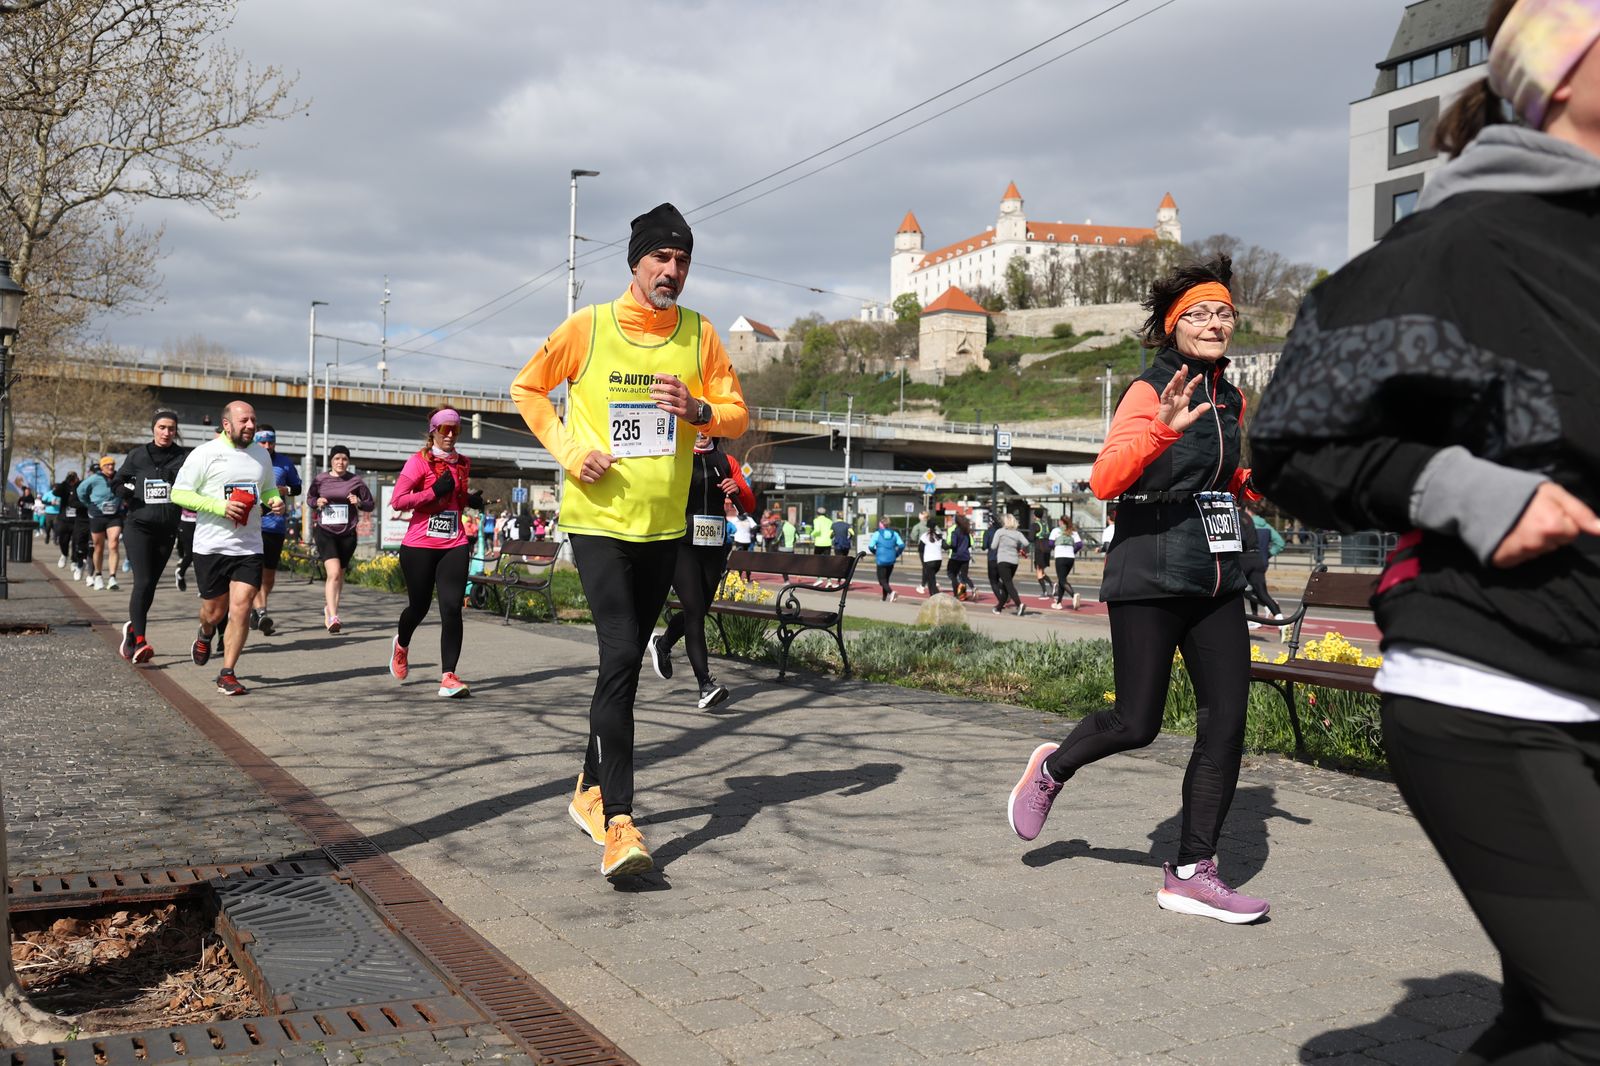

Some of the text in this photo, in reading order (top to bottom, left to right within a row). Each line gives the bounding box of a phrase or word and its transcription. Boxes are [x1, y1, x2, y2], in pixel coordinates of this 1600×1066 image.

[624, 374, 677, 385] AUTOF
[612, 419, 640, 441] 235
[1206, 513, 1233, 534] 10987
